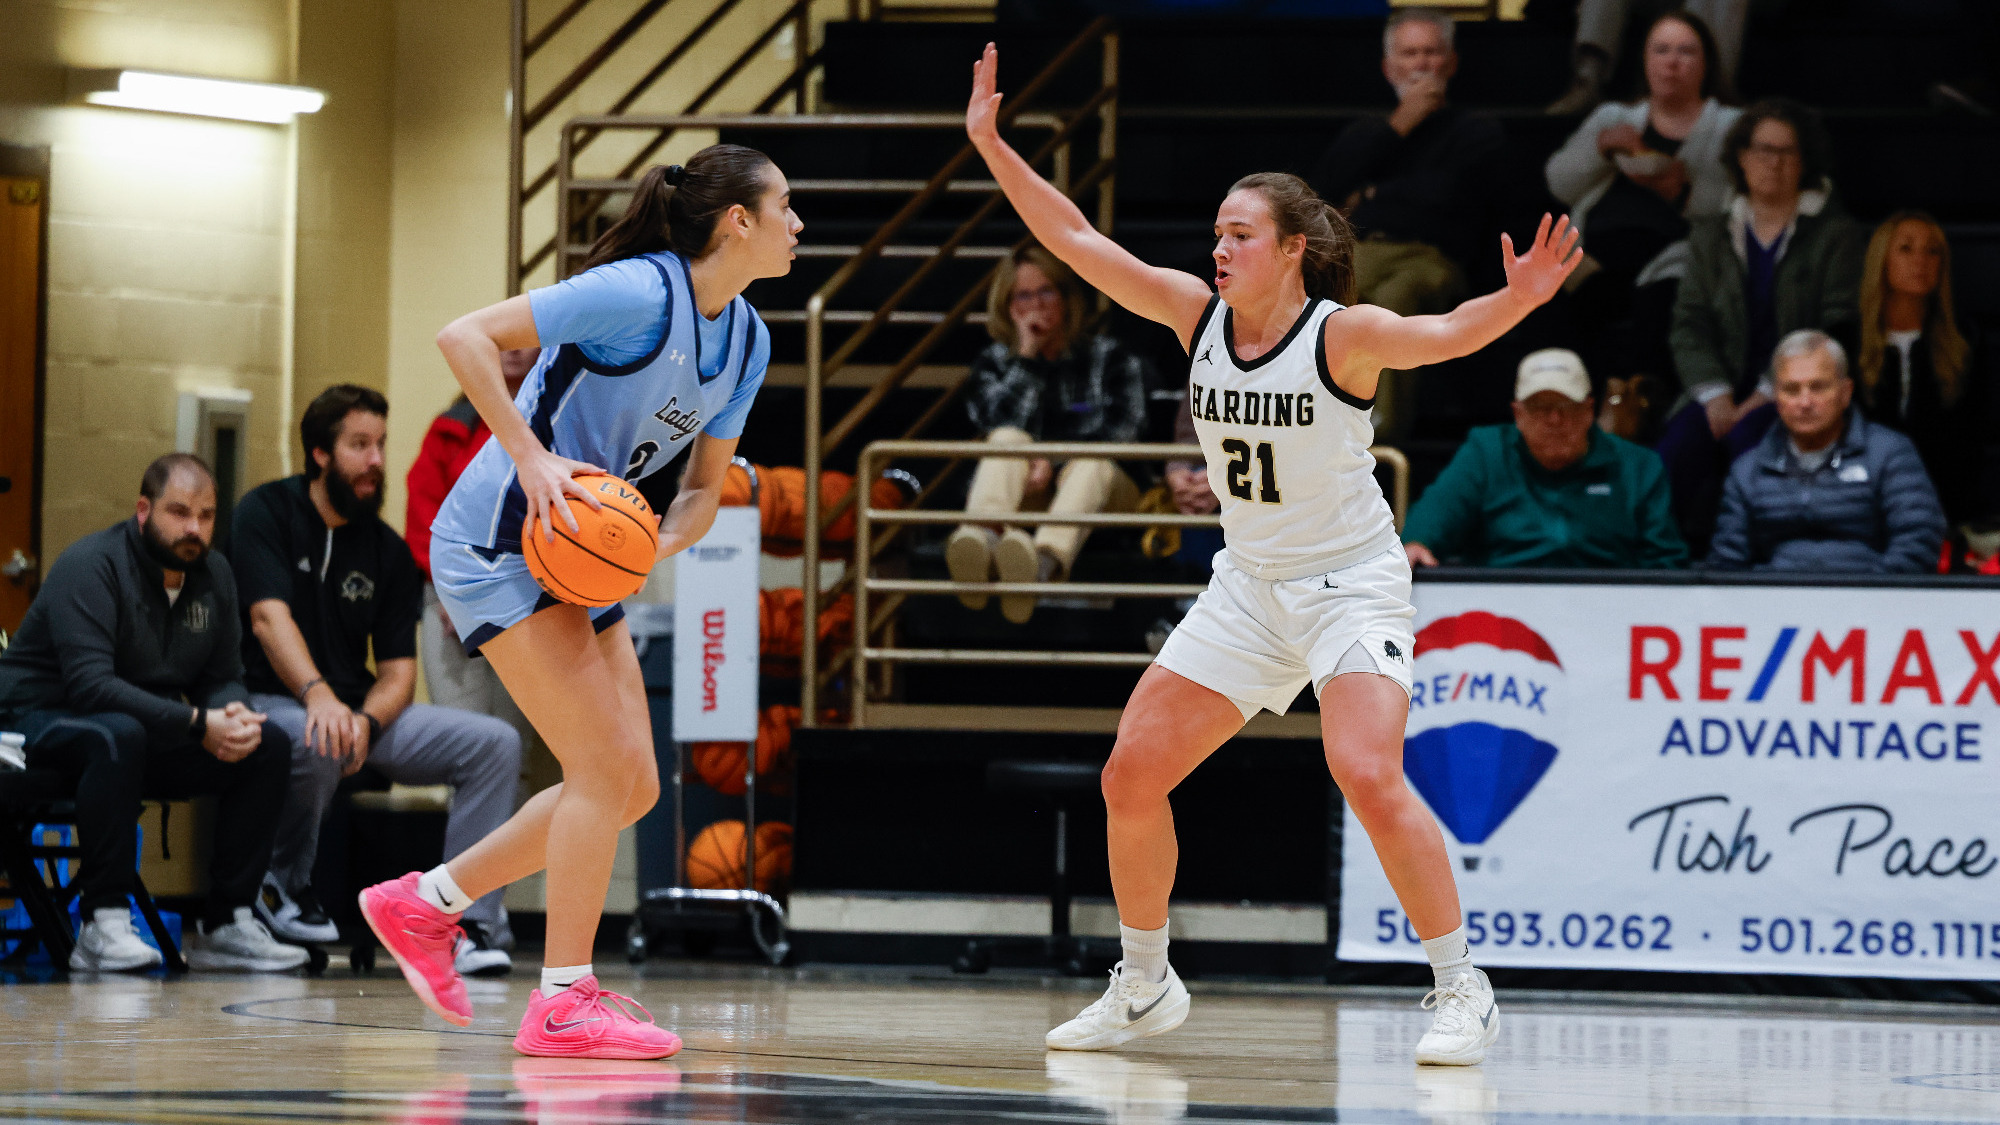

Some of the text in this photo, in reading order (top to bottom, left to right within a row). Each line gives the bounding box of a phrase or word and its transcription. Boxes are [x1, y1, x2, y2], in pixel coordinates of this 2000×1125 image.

[655, 396, 701, 442] Lady
[1192, 383, 1315, 427] HARDING
[1221, 437, 1283, 506] 21
[702, 609, 727, 713] Wilson
[1629, 626, 2000, 706] RE/MAX
[1410, 672, 1548, 715] RE/MAX
[1660, 717, 1982, 762] ADVANTAGE
[1628, 795, 1999, 880] Tish Pace
[1377, 909, 1673, 951] 5593.0262
